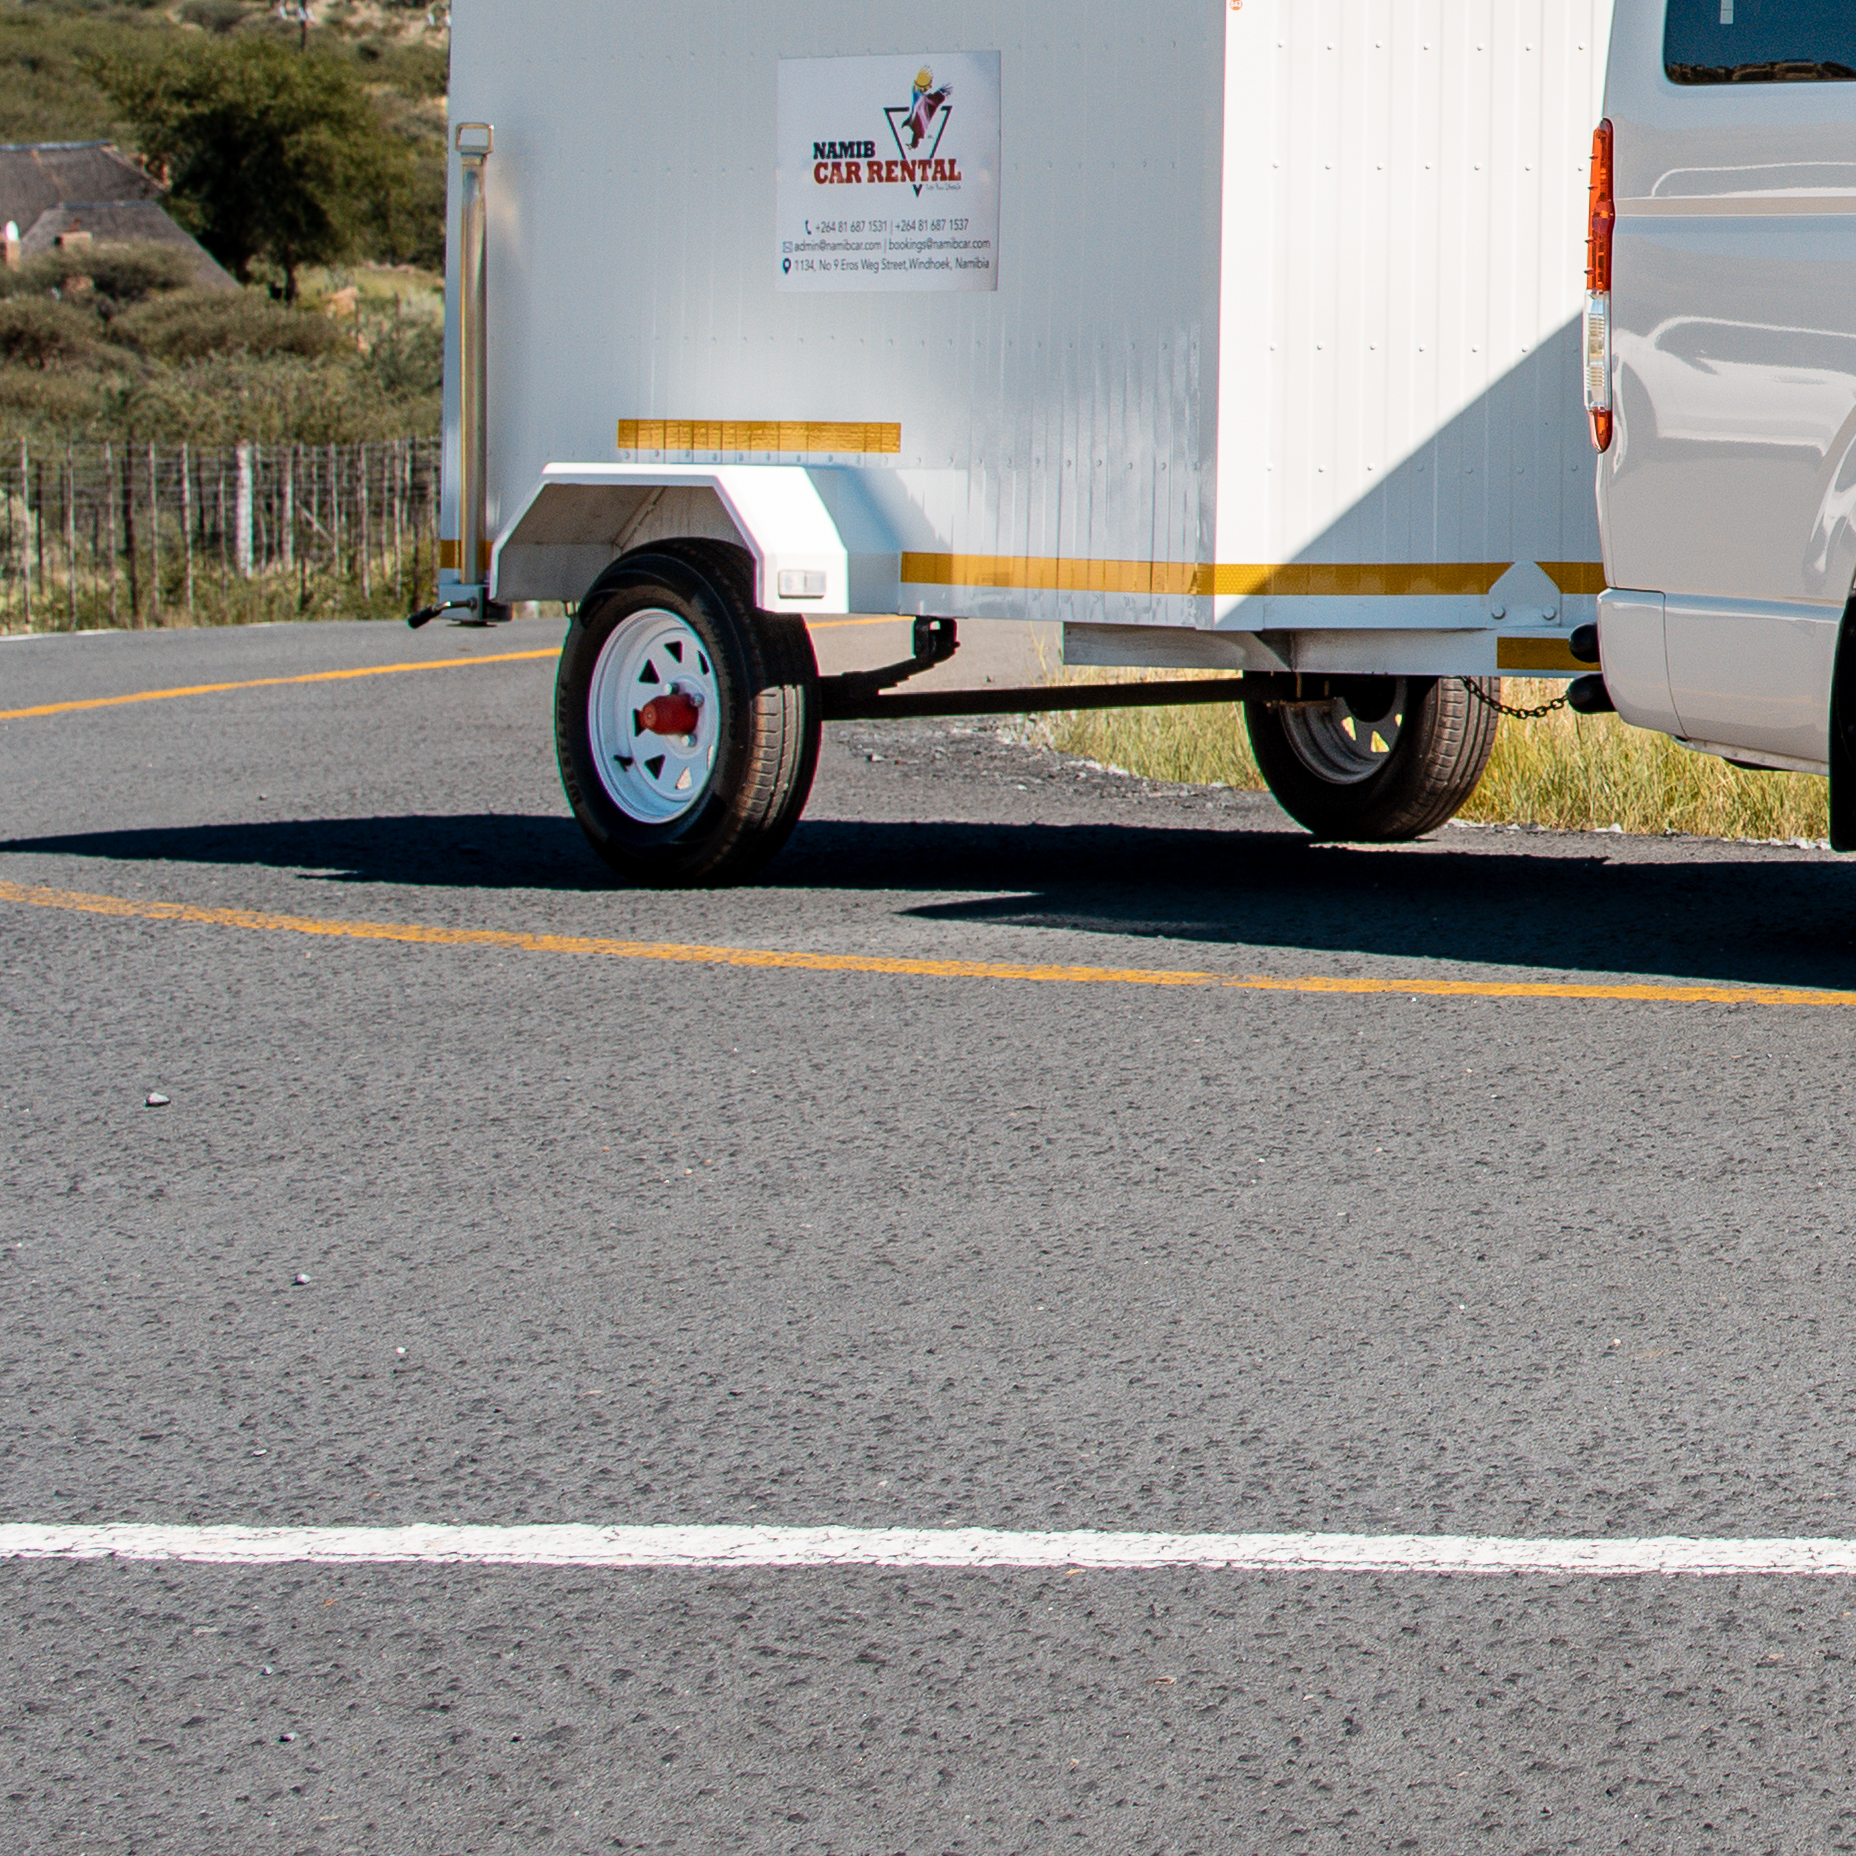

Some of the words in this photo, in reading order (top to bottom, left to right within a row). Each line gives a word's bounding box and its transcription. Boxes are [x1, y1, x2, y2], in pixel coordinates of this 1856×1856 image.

[813, 140, 876, 159] NAMIB
[813, 161, 862, 185] CAR
[866, 159, 962, 183] RENTAL
[815, 221, 836, 233] +264
[838, 221, 848, 233] 81
[850, 220, 866, 233] 687
[868, 220, 887, 232] 1531
[895, 220, 916, 232] +264
[918, 220, 928, 231] 81
[931, 219, 946, 231] 687
[949, 218, 969, 231] 1537
[794, 239, 882, 252] admin@namibcar.com
[888, 237, 991, 253] bookings@namibcar.com
[819, 259, 832, 271] No
[834, 259, 839, 270] 9
[841, 259, 859, 271] Eros
[860, 259, 879, 273] Weg
[955, 257, 990, 269] Namibia
